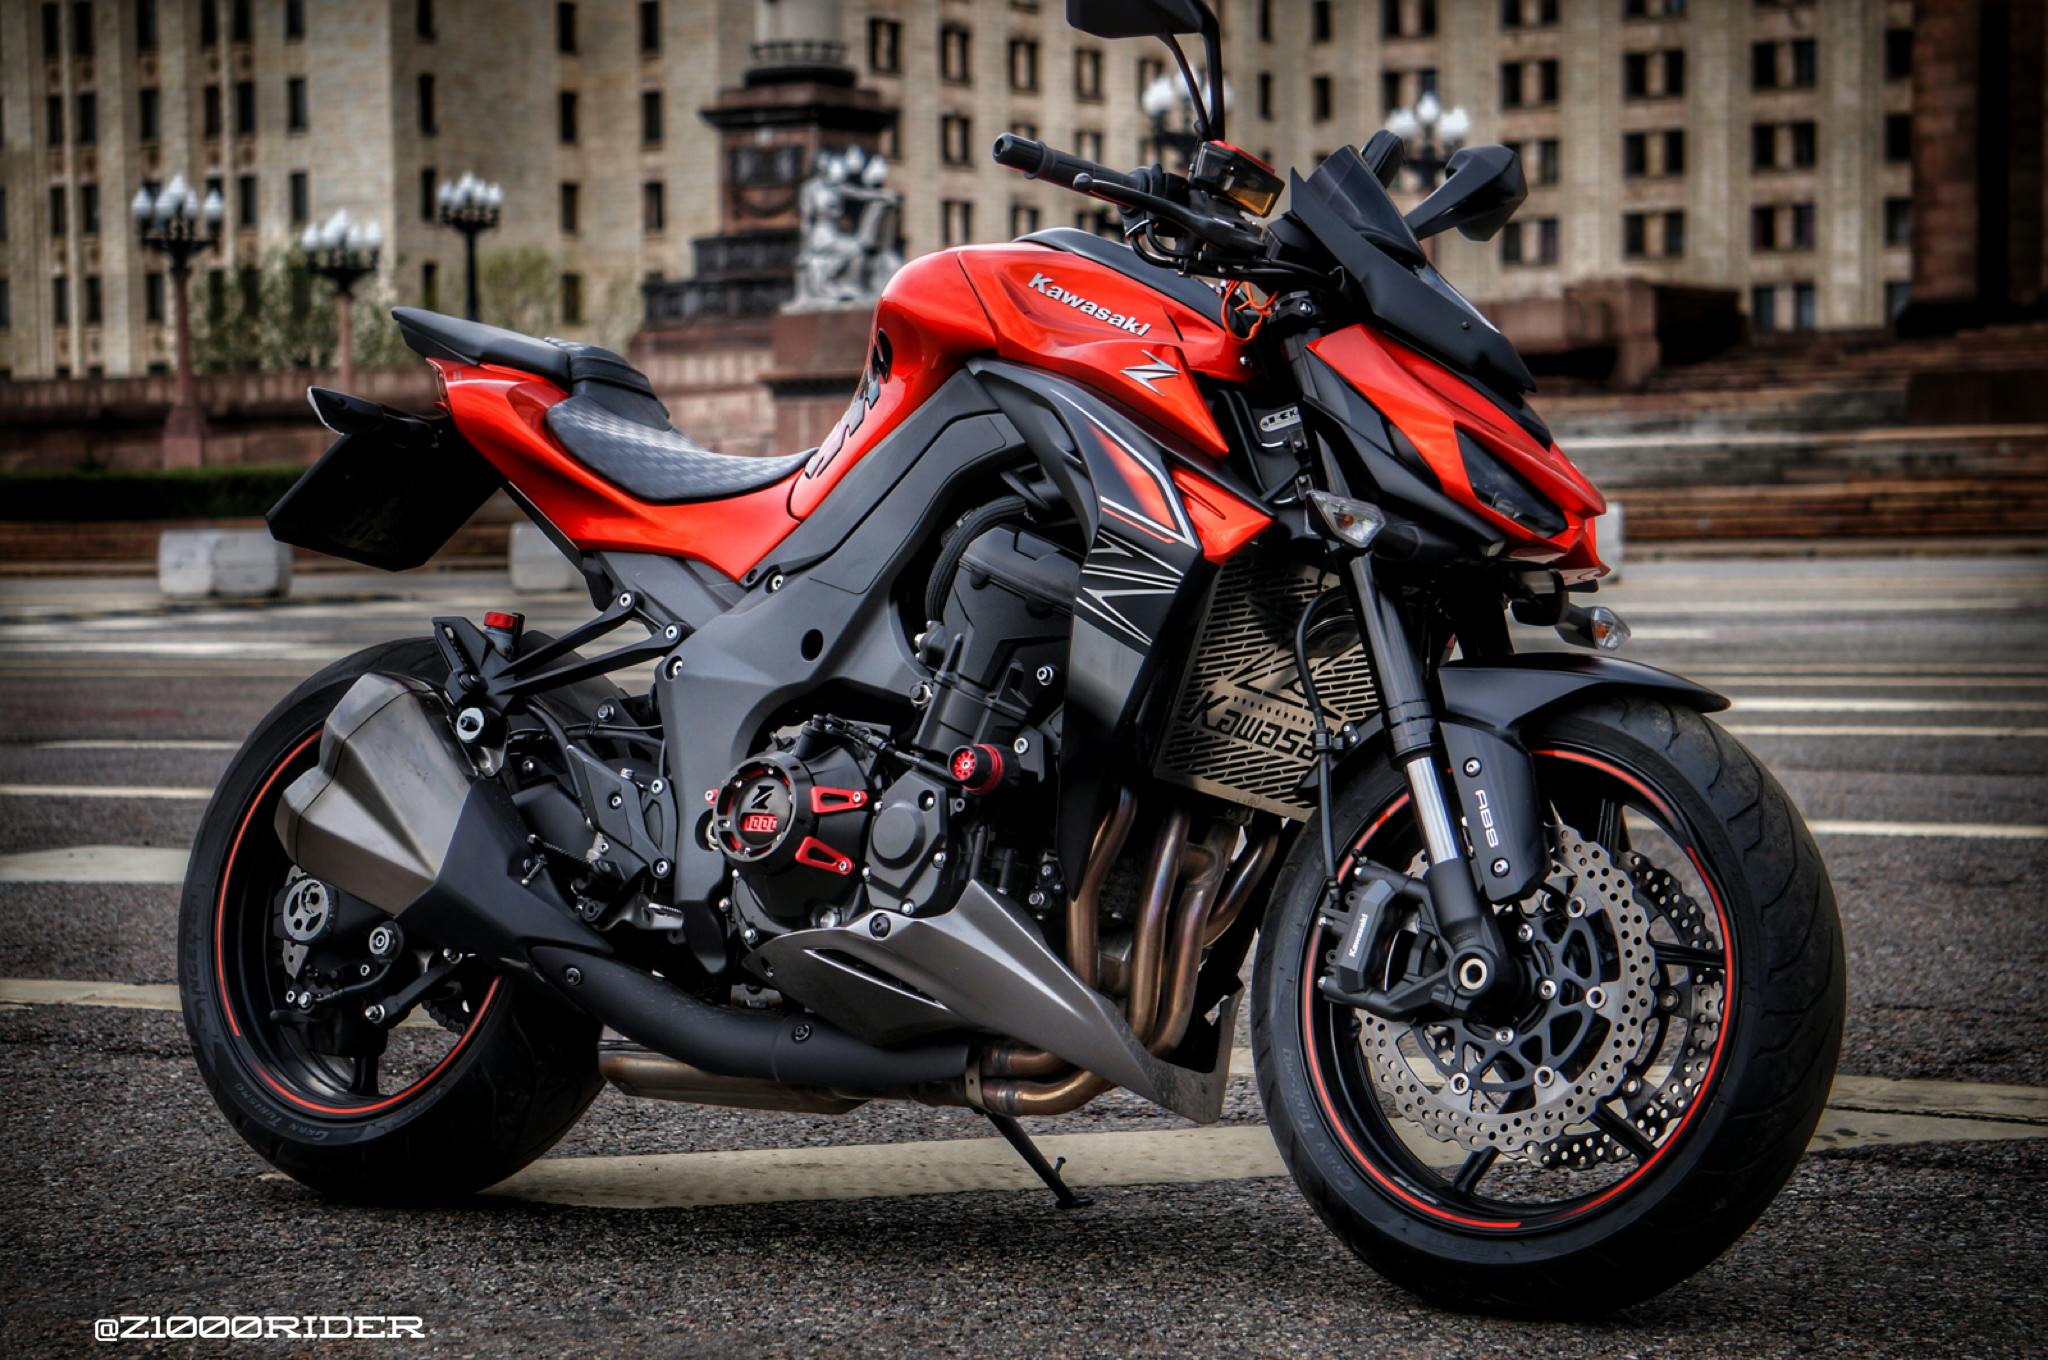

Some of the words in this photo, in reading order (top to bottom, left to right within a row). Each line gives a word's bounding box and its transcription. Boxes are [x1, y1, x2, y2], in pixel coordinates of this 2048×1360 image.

[1028, 272, 1151, 336] Kawasaki
[1185, 690, 1320, 763] Kawasa
[751, 785, 775, 810] Z
[1474, 789, 1499, 848] ABS
